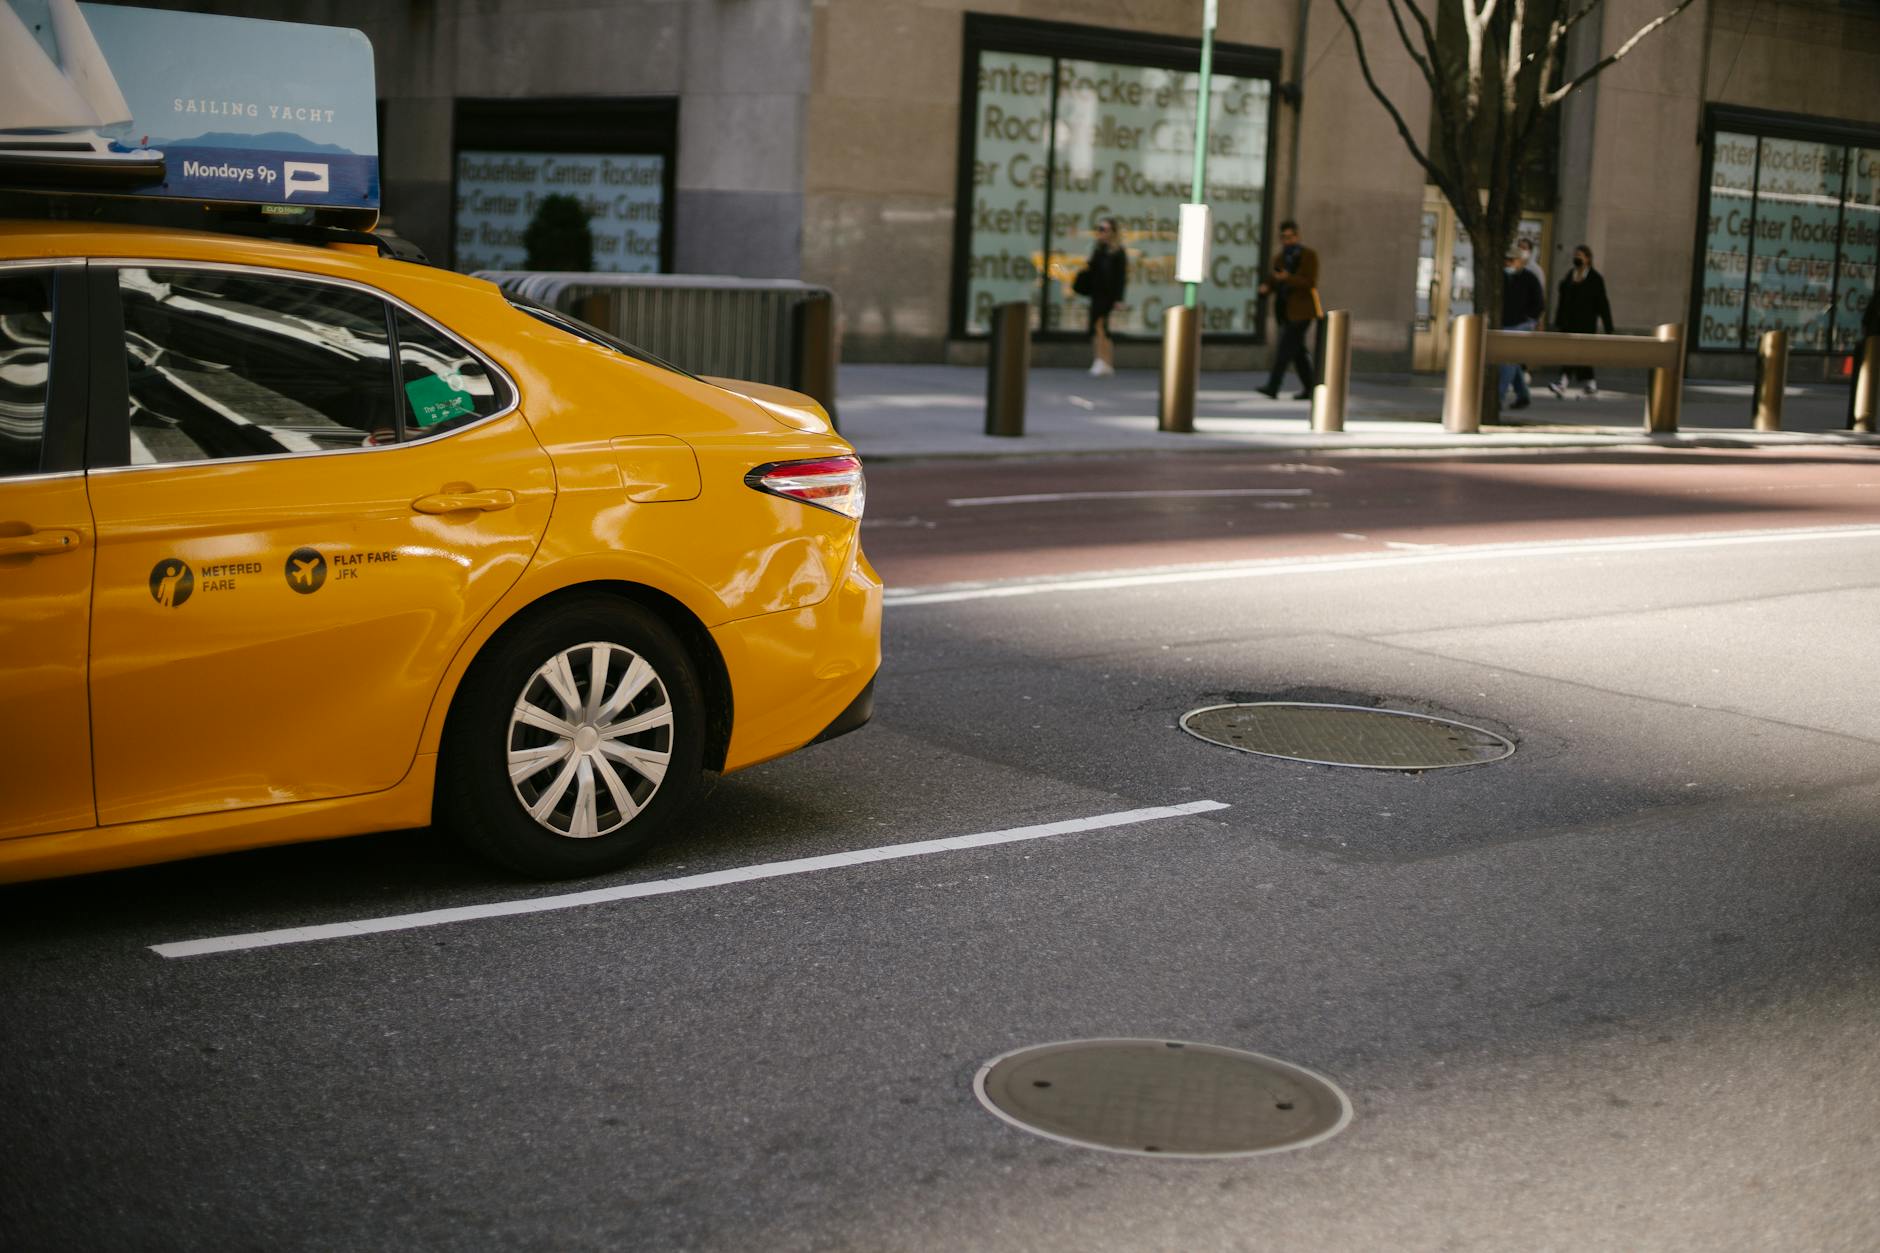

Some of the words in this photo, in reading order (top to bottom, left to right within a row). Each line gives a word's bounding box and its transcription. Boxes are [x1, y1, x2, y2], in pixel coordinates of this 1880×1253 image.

[174, 98, 258, 118] SAILING
[269, 104, 335, 123] YACHT
[183, 160, 255, 182] Mondays
[257, 165, 277, 184] 9p
[333, 553, 364, 566] FLAT
[367, 550, 398, 564] FARE
[201, 562, 262, 577] METERED
[335, 568, 358, 581] JFK
[202, 579, 236, 592] FARE
